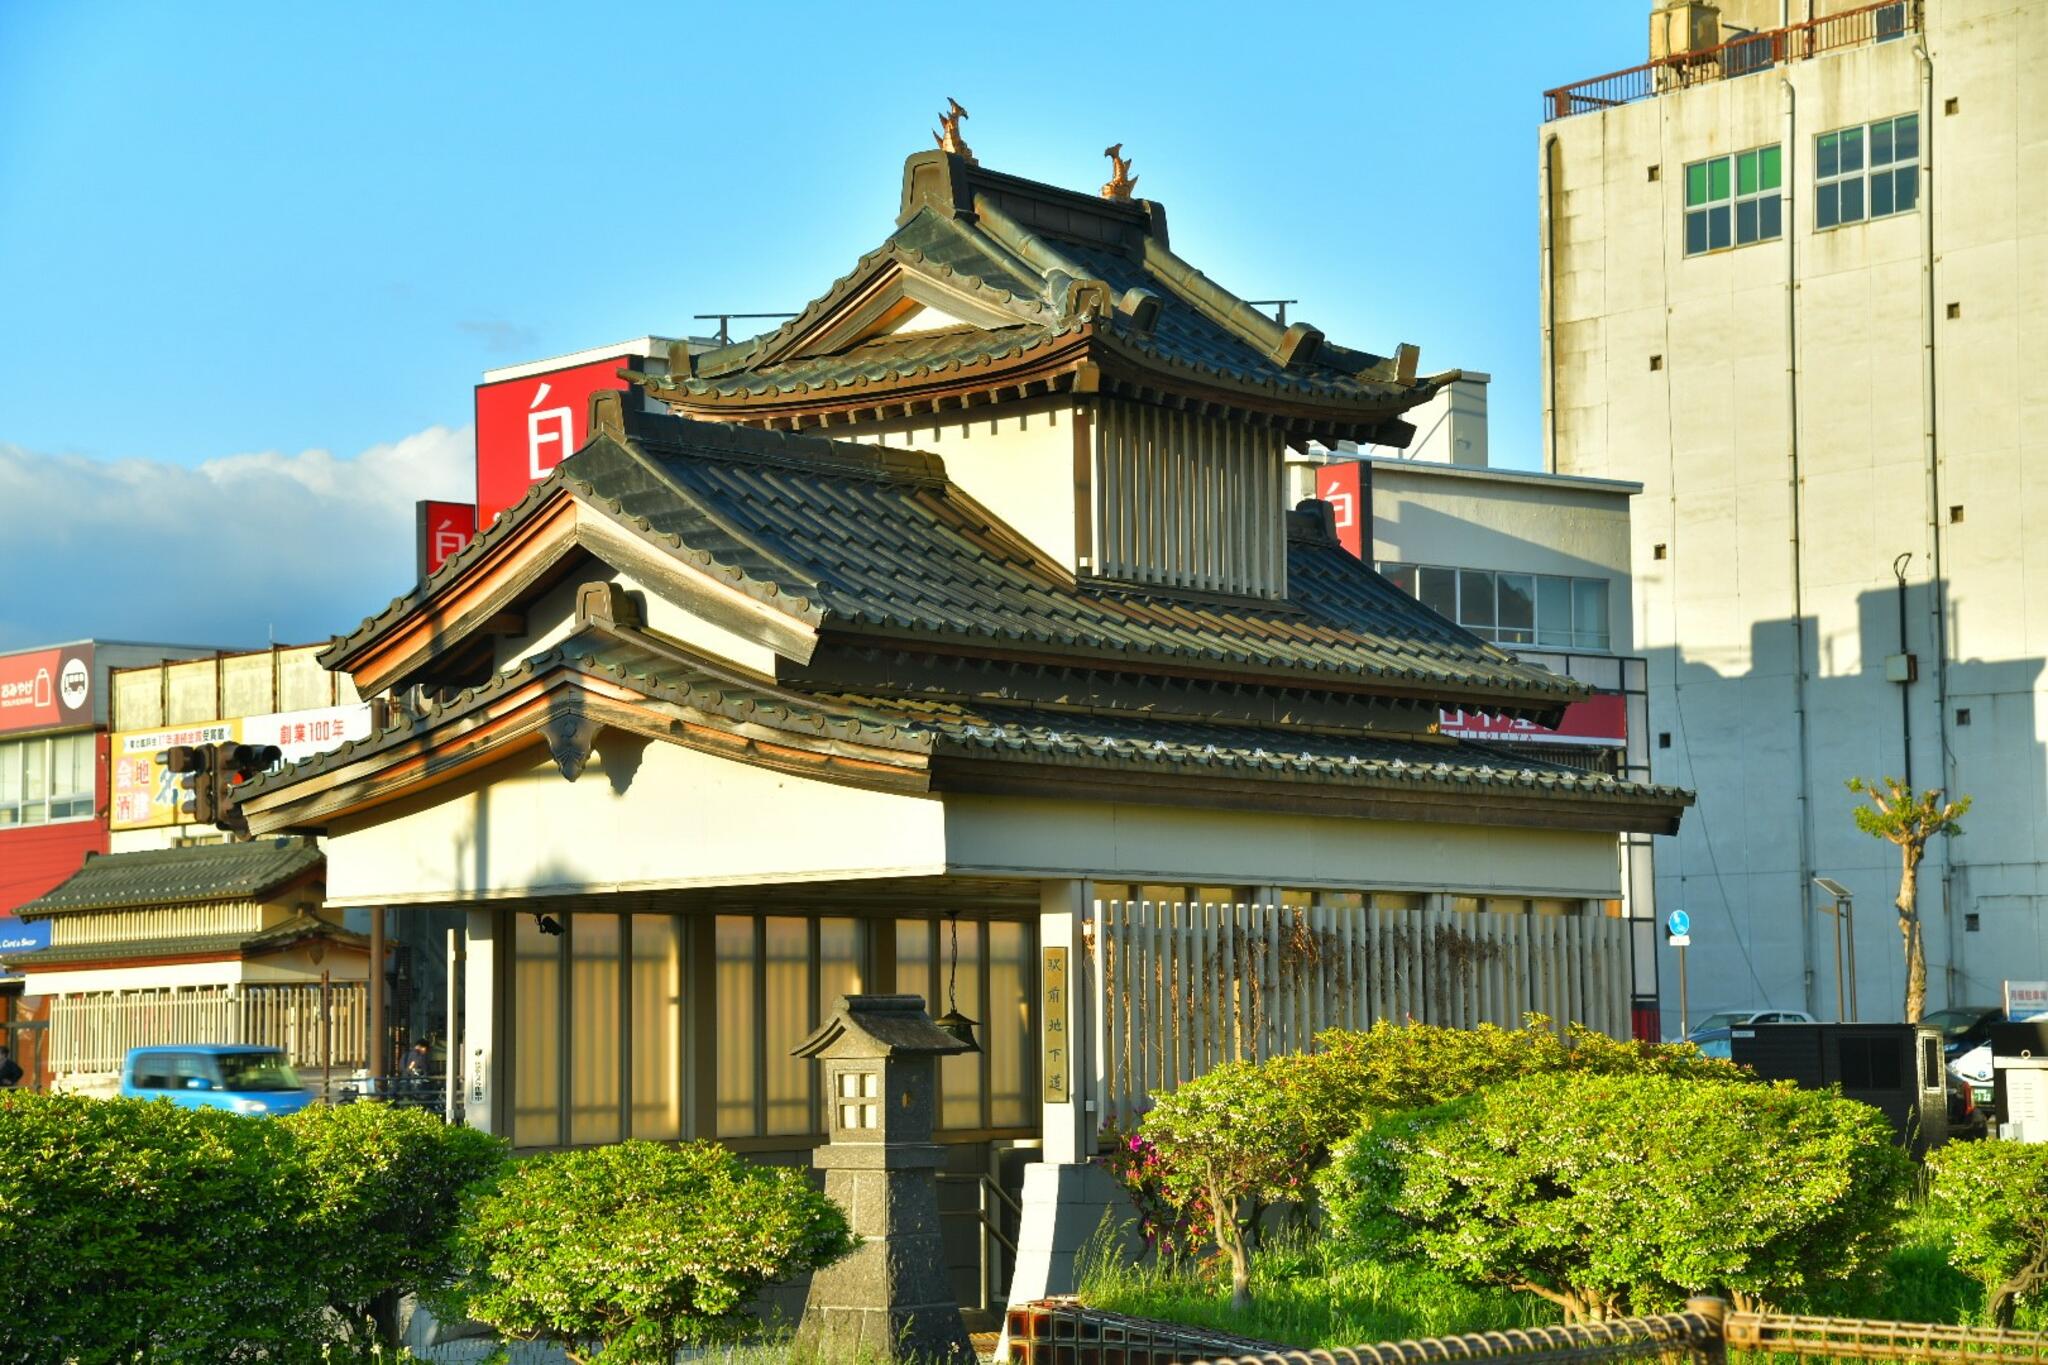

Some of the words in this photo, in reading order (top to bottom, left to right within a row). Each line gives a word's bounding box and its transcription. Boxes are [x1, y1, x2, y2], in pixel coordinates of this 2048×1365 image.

[528, 383, 574, 479] 白
[280, 719, 344, 744] 創業100年
[1047, 958, 1063, 1092] 駅前地下道
